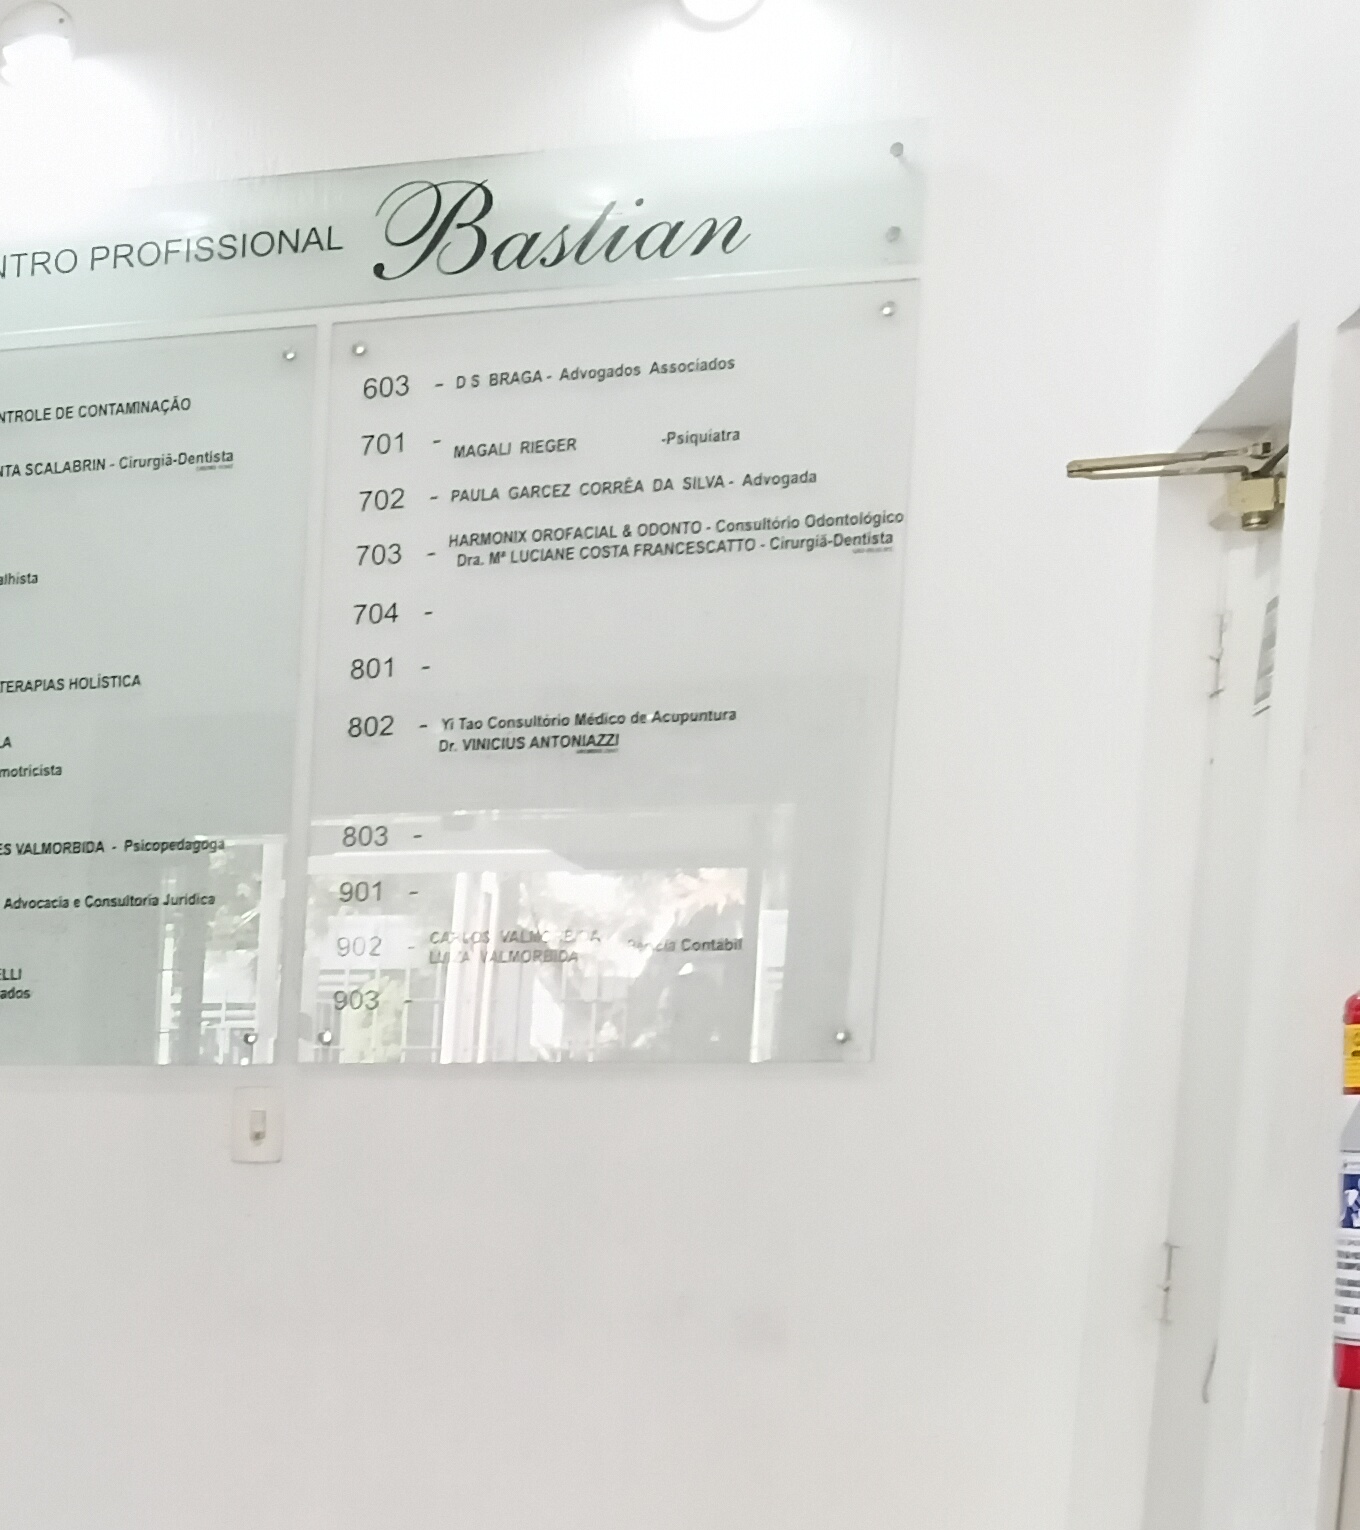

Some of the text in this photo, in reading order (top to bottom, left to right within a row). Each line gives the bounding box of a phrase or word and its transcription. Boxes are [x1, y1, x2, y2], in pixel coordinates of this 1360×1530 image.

[90, 226, 343, 271] PROFISSIONAL
[373, 179, 751, 280] Bastian
[364, 375, 409, 399] 603
[456, 376, 466, 389] D
[471, 374, 480, 388] S
[489, 370, 543, 386] BRAGA
[559, 364, 641, 382] Advogados
[649, 358, 735, 375] Associados
[56, 406, 74, 420] DE
[78, 396, 191, 418] CONTAMINAÇÃO
[361, 432, 403, 456] 701
[454, 442, 511, 458] MAGALI
[520, 438, 576, 454] RIEGER
[25, 459, 105, 476] SCALABRIN
[119, 451, 233, 471] Cirurgiã-Dentista
[359, 488, 404, 512] 702
[451, 488, 500, 502] PAULA
[508, 483, 571, 500] GARCEZ
[579, 477, 644, 496] CORRÊA
[652, 478, 674, 492] DA
[682, 475, 725, 490] SILVA
[742, 471, 817, 489] Advogada
[449, 530, 527, 547] HARMONIX
[532, 525, 618, 542] OROFACIAL
[622, 524, 632, 537] &
[637, 521, 702, 537] ODONTO
[715, 516, 800, 533] Consultório
[805, 510, 904, 528] Odontológico
[356, 543, 402, 566] 703
[457, 554, 484, 567] Dra.
[511, 547, 575, 563] LUCIANE
[579, 544, 630, 560] COSTA
[634, 538, 756, 557] FRANCESCATTO
[354, 602, 398, 625] 704
[351, 657, 393, 680] 801
[69, 673, 141, 690] HOLÍSTICA
[348, 715, 394, 738] 802
[442, 718, 454, 730] Yi
[459, 717, 483, 730] Tao
[487, 714, 570, 729] Consultório
[575, 713, 626, 726] Médico
[630, 711, 647, 724] de
[651, 710, 736, 725] Acupuntura
[439, 733, 619, 752] Dr. VINICIUS ANTONIAZZI
[16, 841, 104, 855] VALMORBIDA
[124, 838, 225, 854] Psicopedagoga
[342, 825, 389, 848] 803
[4, 896, 69, 909] Advocacia
[339, 881, 382, 903] 901
[337, 936, 382, 958] 902
[333, 990, 380, 1012] 903
